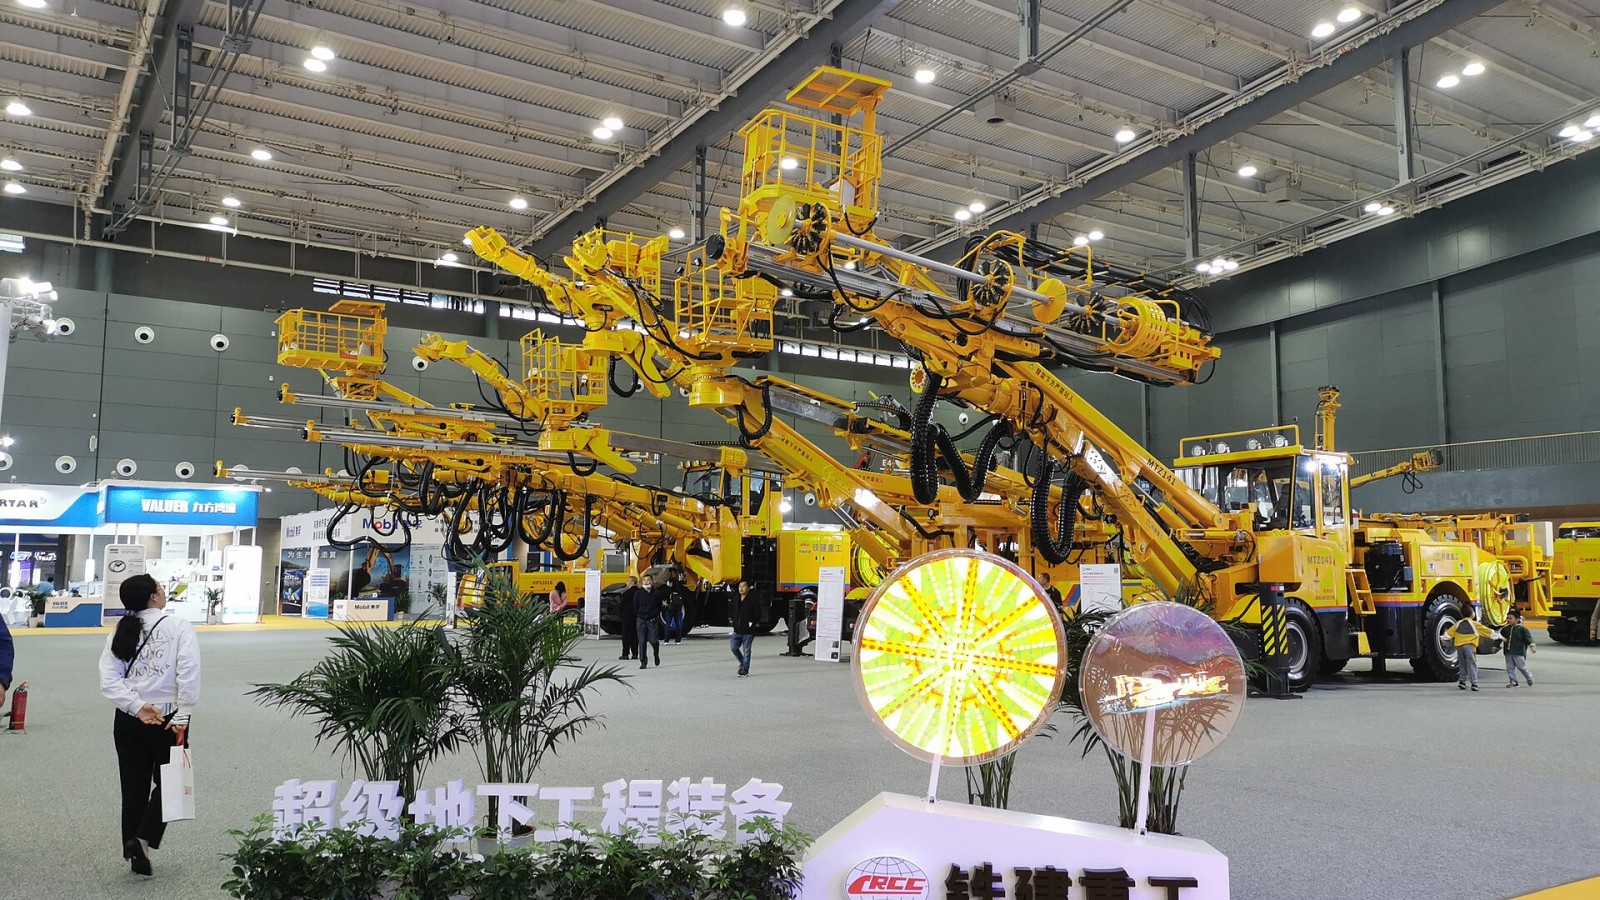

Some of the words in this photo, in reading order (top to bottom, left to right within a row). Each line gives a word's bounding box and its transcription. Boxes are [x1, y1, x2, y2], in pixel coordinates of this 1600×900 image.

[1147, 458, 1176, 486] MTZ141
[141, 498, 189, 514] VALUER
[362, 518, 399, 530] Mobl
[812, 543, 842, 553] 铁建重工
[1307, 555, 1333, 564] MTZ141
[271, 777, 793, 844] 超级地下工程装备
[848, 875, 926, 894] CRCC
